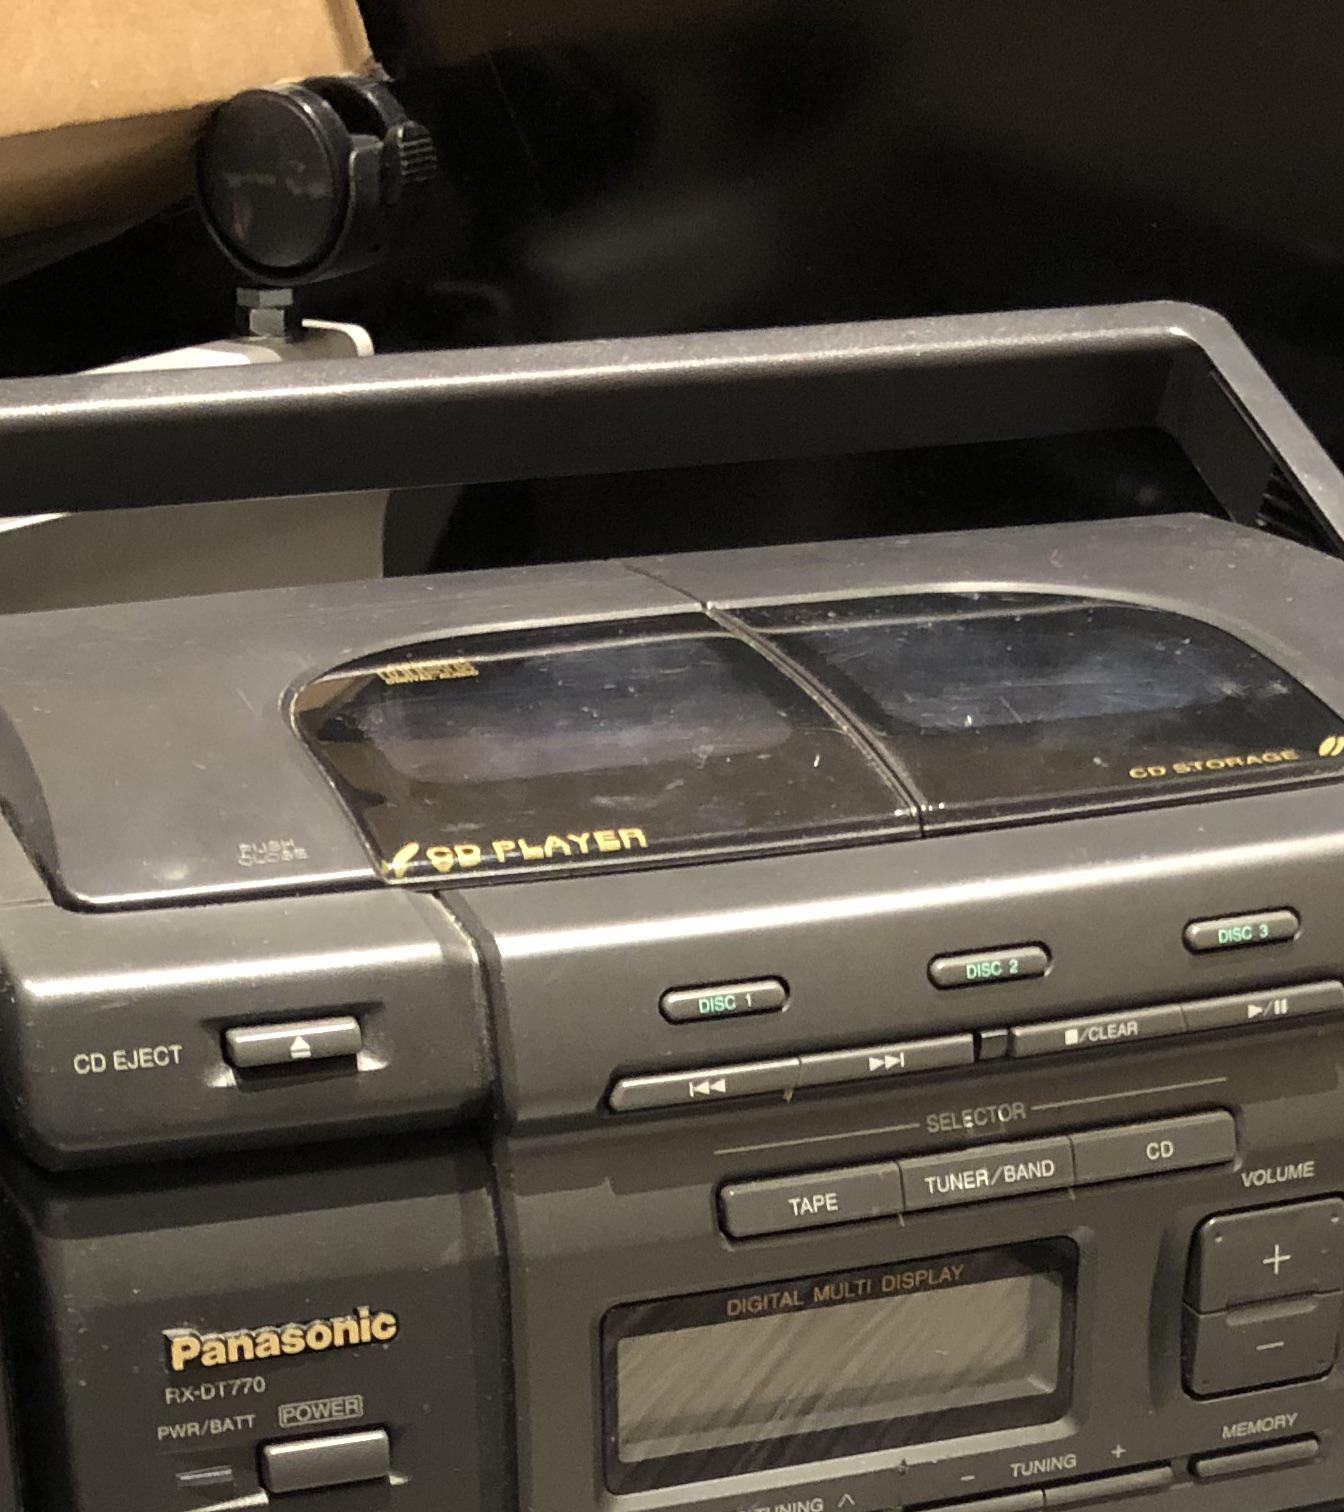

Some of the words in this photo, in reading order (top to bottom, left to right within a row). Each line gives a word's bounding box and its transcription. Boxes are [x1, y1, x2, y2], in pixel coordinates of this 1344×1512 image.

[1128, 763, 1166, 780] CD
[1173, 749, 1299, 775] STORAGE
[426, 844, 482, 873] CD
[491, 827, 648, 864] PLAYER
[1218, 925, 1253, 944] DISC
[1258, 924, 1268, 939] 3
[966, 961, 1002, 979] DISC
[1008, 960, 1019, 974] 2
[698, 995, 737, 1014] DISC
[744, 994, 753, 1008] 1
[73, 1052, 106, 1076] CD
[113, 1045, 183, 1072] EJECT
[926, 1102, 1026, 1134] SELECTOR
[1146, 1142, 1174, 1161] CD
[925, 1159, 1055, 1193] TUNER/BAND
[1242, 1161, 1315, 1188] VOLUME
[788, 1193, 838, 1216] TAPE
[726, 1290, 804, 1317] DIGITAL
[813, 1278, 872, 1303] MULTI
[882, 1264, 965, 1292] DISPLAY
[168, 1308, 398, 1371] Panasonic
[165, 1375, 266, 1405] RX-DT770
[281, 1398, 360, 1424] POWER
[157, 1414, 256, 1440] PWR/BATT
[1222, 1412, 1298, 1439] MEMORY
[1010, 1454, 1077, 1478] TUNING
